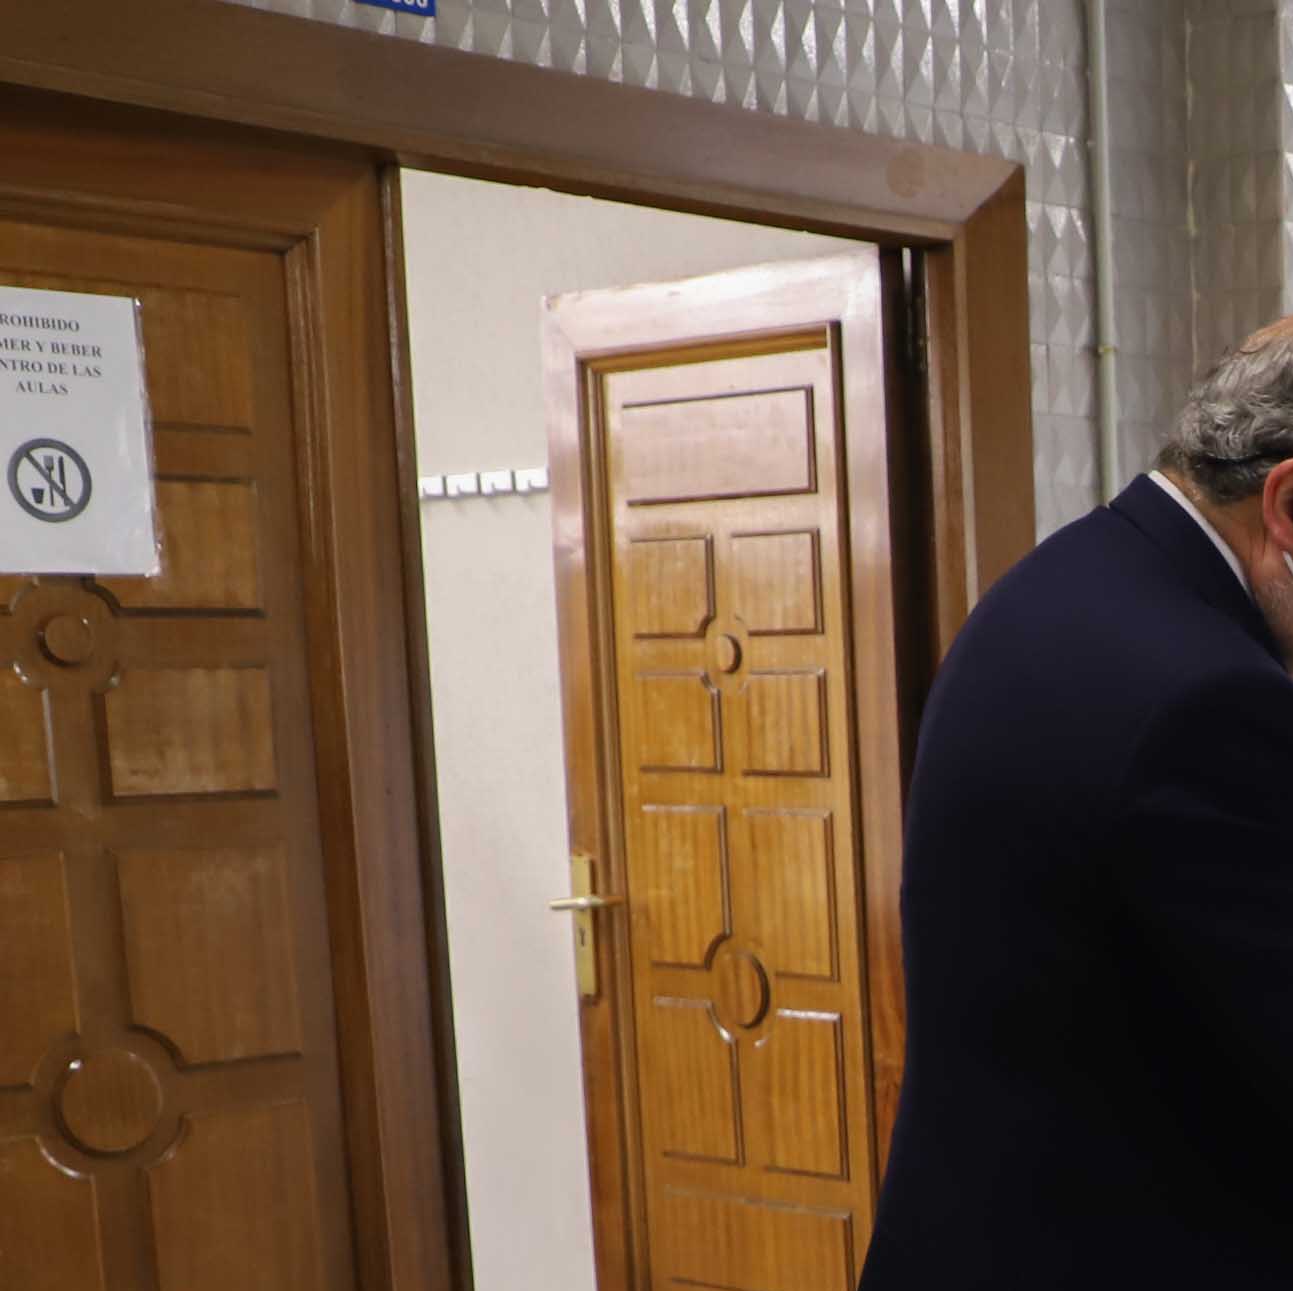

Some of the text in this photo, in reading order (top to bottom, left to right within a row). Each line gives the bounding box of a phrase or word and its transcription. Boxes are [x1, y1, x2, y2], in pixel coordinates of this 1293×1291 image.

[35, 339, 44, 353] Y
[50, 341, 102, 358] BEBER
[47, 361, 68, 376] DE
[72, 363, 102, 377] LAS
[16, 381, 70, 396] AULAS
